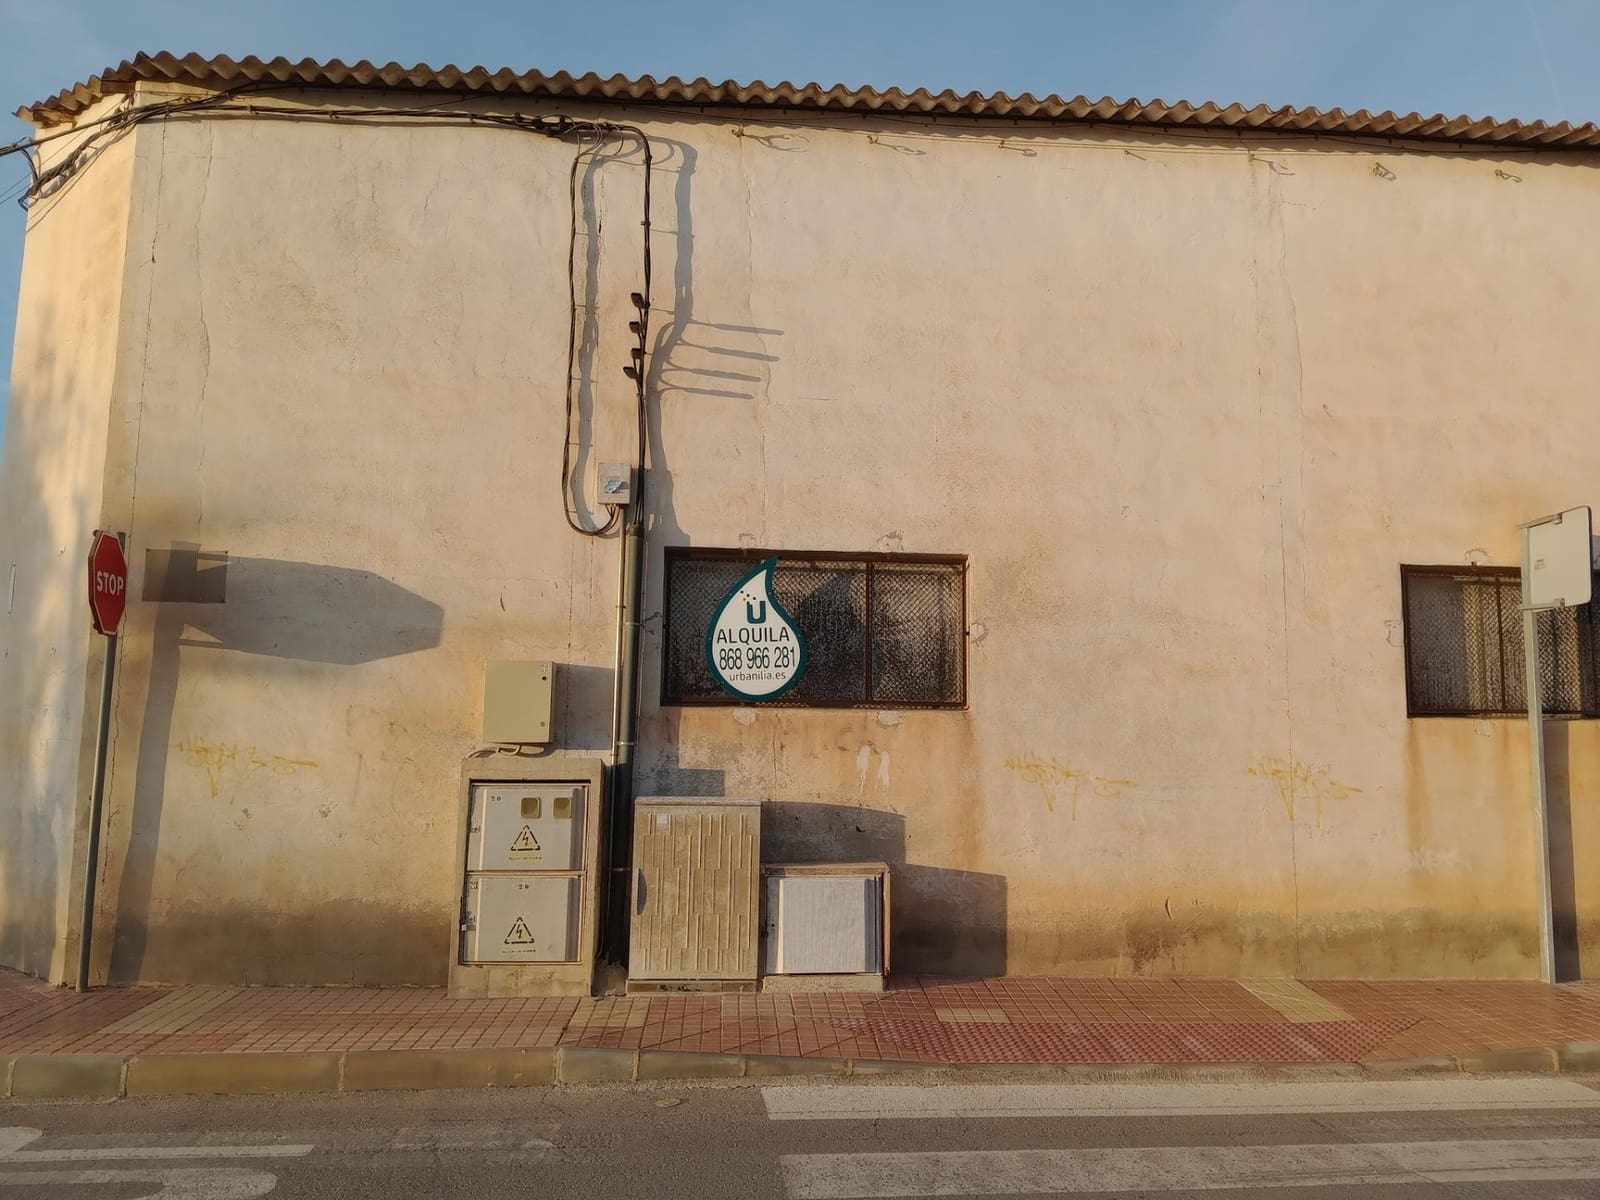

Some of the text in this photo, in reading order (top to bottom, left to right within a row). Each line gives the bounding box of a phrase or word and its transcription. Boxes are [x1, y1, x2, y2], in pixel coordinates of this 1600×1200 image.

[96, 570, 124, 596] STOP
[717, 626, 789, 645] ALQUILA
[719, 646, 795, 670] 868 966 281
[729, 671, 786, 681] urbanilia.es
